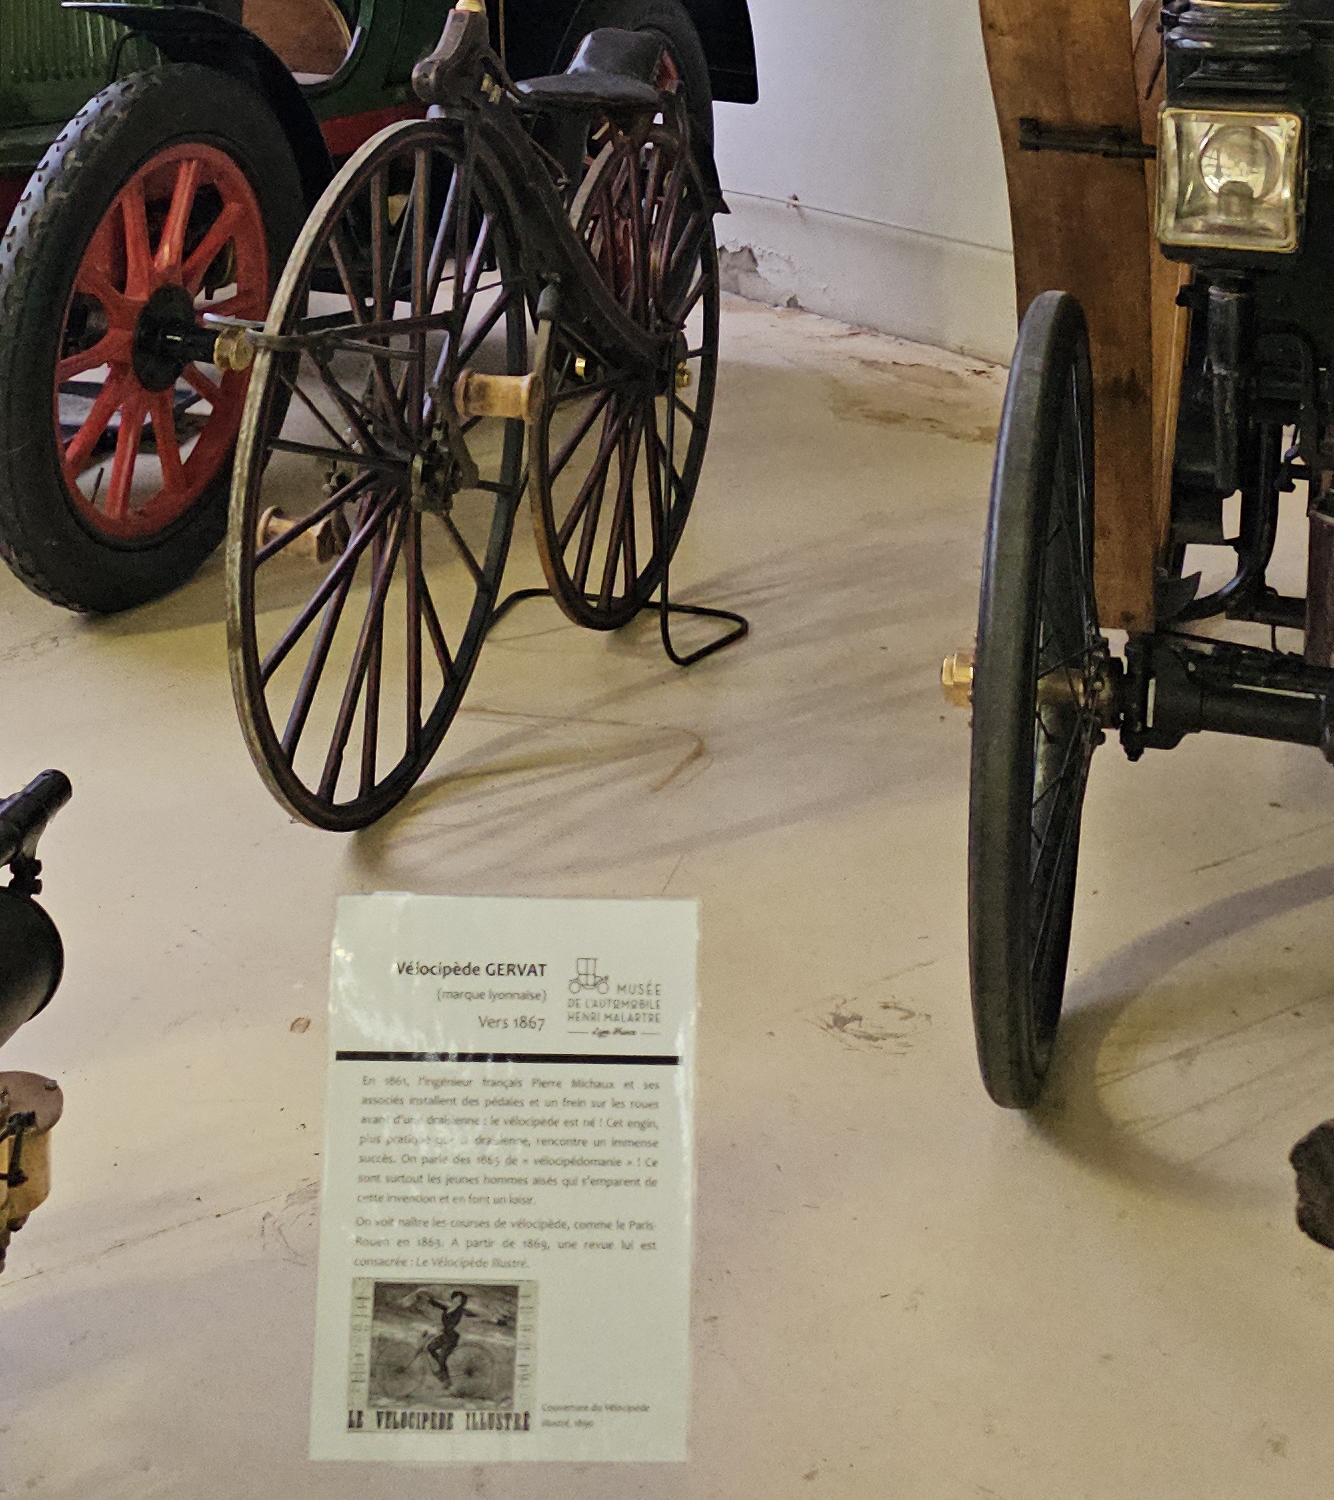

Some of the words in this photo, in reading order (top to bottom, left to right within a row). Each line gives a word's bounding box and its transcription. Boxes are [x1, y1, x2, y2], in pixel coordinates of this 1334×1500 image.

[397, 960, 480, 979] Vélocipède
[485, 962, 547, 977] GERVAT
[437, 987, 486, 1002] (marque
[488, 988, 547, 1003] lyonnaise)
[616, 979, 661, 996] MUSÉE
[567, 998, 580, 1009] DE
[585, 998, 661, 1010] L'AUTOMOBILE
[478, 1015, 509, 1029] Vers
[513, 1015, 546, 1032] 1867
[567, 1011, 601, 1022] HENRI
[603, 1012, 661, 1023] MALARTRE
[362, 1075, 375, 1086] En
[418, 1076, 473, 1090] l'ingénieur
[482, 1077, 523, 1090] français
[531, 1078, 563, 1088] Pierre
[571, 1078, 615, 1089] Michaux
[623, 1080, 634, 1090] et
[643, 1081, 660, 1090] ses
[360, 1095, 404, 1106] associés
[409, 1095, 457, 1106] installent
[461, 1095, 479, 1106] des
[529, 1098, 540, 1107] et
[544, 1099, 558, 1108] un
[562, 1097, 586, 1108] frein
[591, 1100, 606, 1108] sur
[611, 1097, 626, 1109] les
[630, 1100, 659, 1109] roues
[490, 1115, 500, 1126] le
[504, 1116, 560, 1129] vélocipède
[563, 1118, 579, 1127] est
[583, 1117, 595, 1127] né
[606, 1117, 623, 1128] Cet
[627, 1118, 659, 1131] engin,
[536, 1138, 589, 1148] rencontre
[593, 1139, 607, 1148] un
[611, 1137, 659, 1148] immense
[358, 1153, 396, 1164] succès.
[401, 1153, 417, 1164] On
[421, 1154, 448, 1166] parle
[505, 1155, 518, 1166] de
[645, 1157, 658, 1167] Ce
[357, 1174, 381, 1184] sont
[385, 1174, 424, 1184] surtout
[427, 1173, 441, 1184] les
[445, 1174, 480, 1186] jeunes
[483, 1174, 528, 1186] hommes
[562, 1176, 578, 1188] qui
[644, 1176, 658, 1187] de
[357, 1194, 384, 1203] cette
[386, 1193, 436, 1203] invention
[439, 1194, 449, 1204] et
[452, 1195, 466, 1204] en
[493, 1195, 506, 1205] un
[356, 1216, 372, 1227] On
[375, 1216, 395, 1227] voit
[431, 1217, 447, 1228] les
[450, 1218, 491, 1228] courses
[493, 1217, 507, 1229] de
[510, 1218, 570, 1231] vélocipède,
[574, 1220, 613, 1230] comme
[616, 1218, 626, 1230] le
[355, 1236, 390, 1247] Rouen
[396, 1238, 410, 1247] en
[465, 1237, 495, 1250] partir
[501, 1238, 516, 1249] de
[557, 1240, 578, 1250] une
[583, 1240, 615, 1250] revue
[620, 1239, 635, 1250] lui
[640, 1241, 657, 1251] est
[353, 1256, 408, 1267] consacrée
[416, 1257, 429, 1268] Le
[431, 1256, 489, 1269] Vélocipède
[348, 1410, 364, 1429] LE
